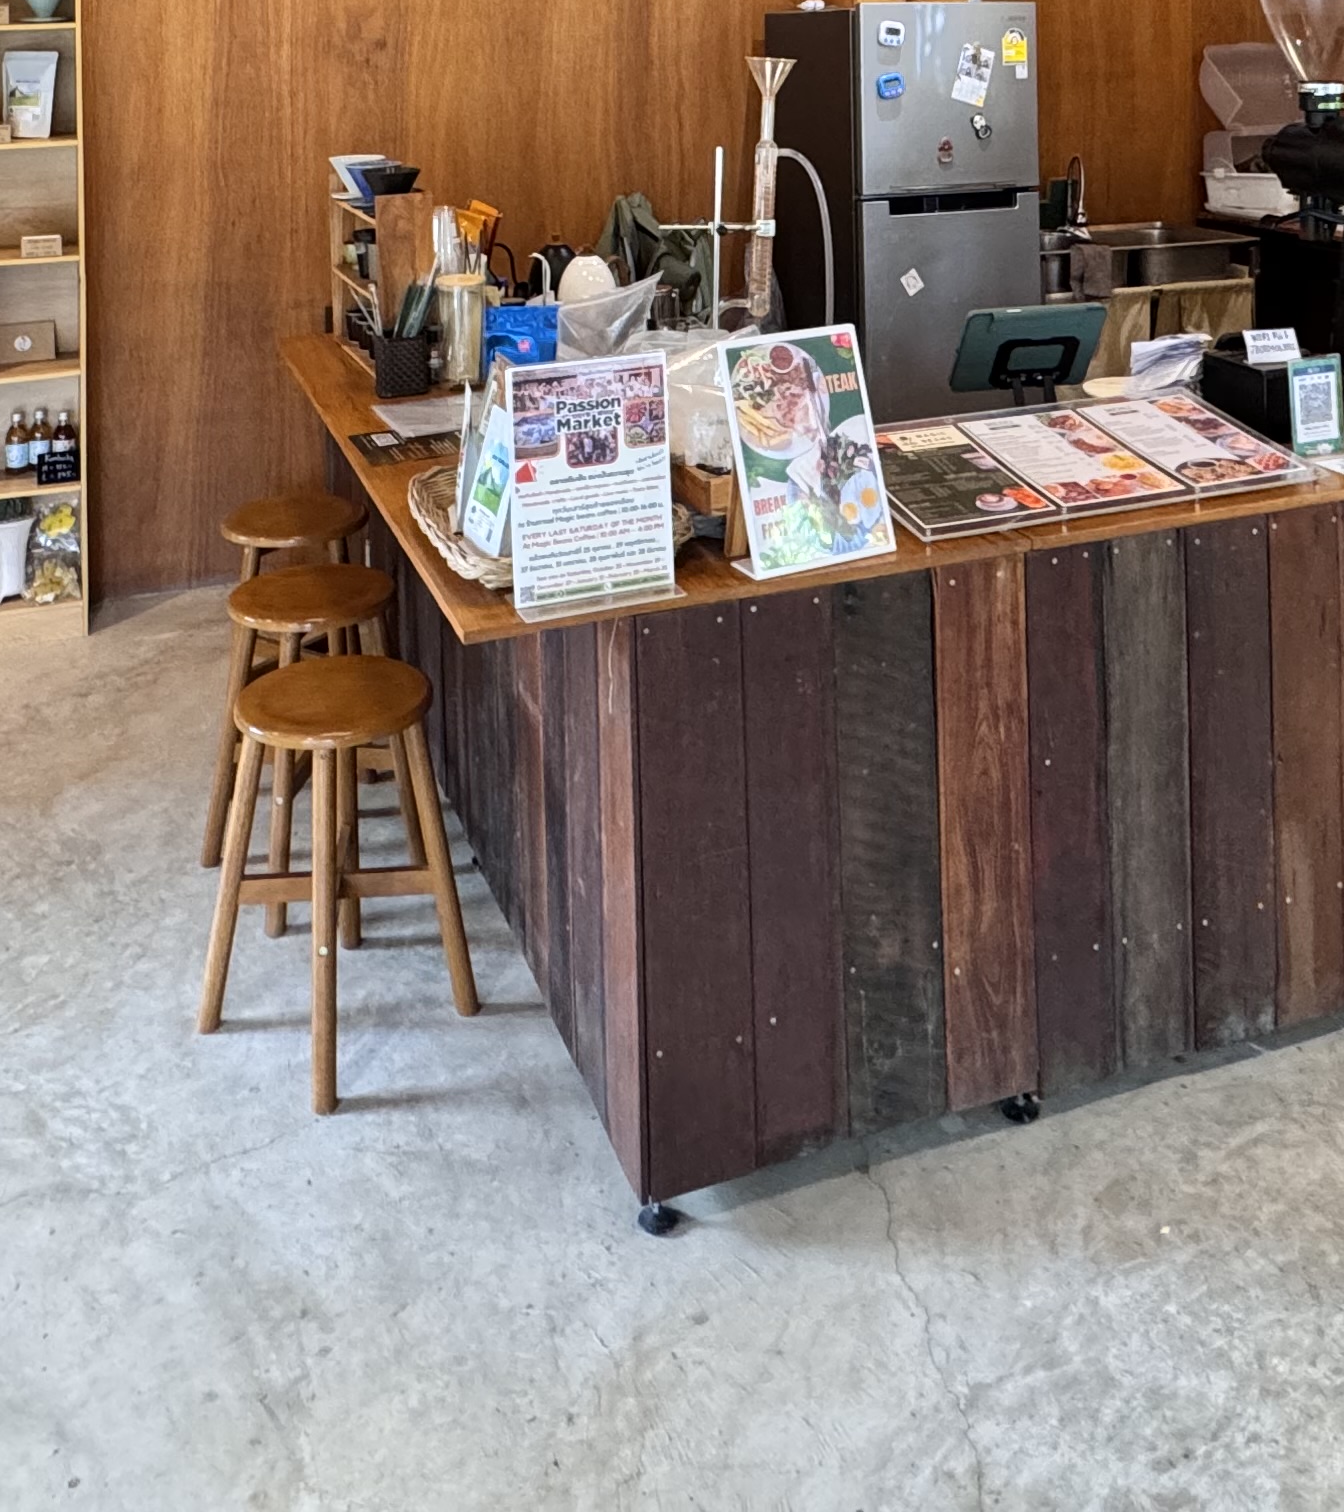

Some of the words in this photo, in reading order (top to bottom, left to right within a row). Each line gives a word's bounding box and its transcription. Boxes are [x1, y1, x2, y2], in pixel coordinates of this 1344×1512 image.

[556, 397, 621, 415] Passion
[556, 413, 621, 432] Market
[753, 493, 787, 516] BREAK
[522, 531, 547, 541] EVERY
[548, 528, 567, 538] LAST
[569, 522, 609, 535] SATURDAY
[610, 520, 621, 528] OF
[622, 518, 635, 527] THE
[636, 514, 663, 525] MONTH
